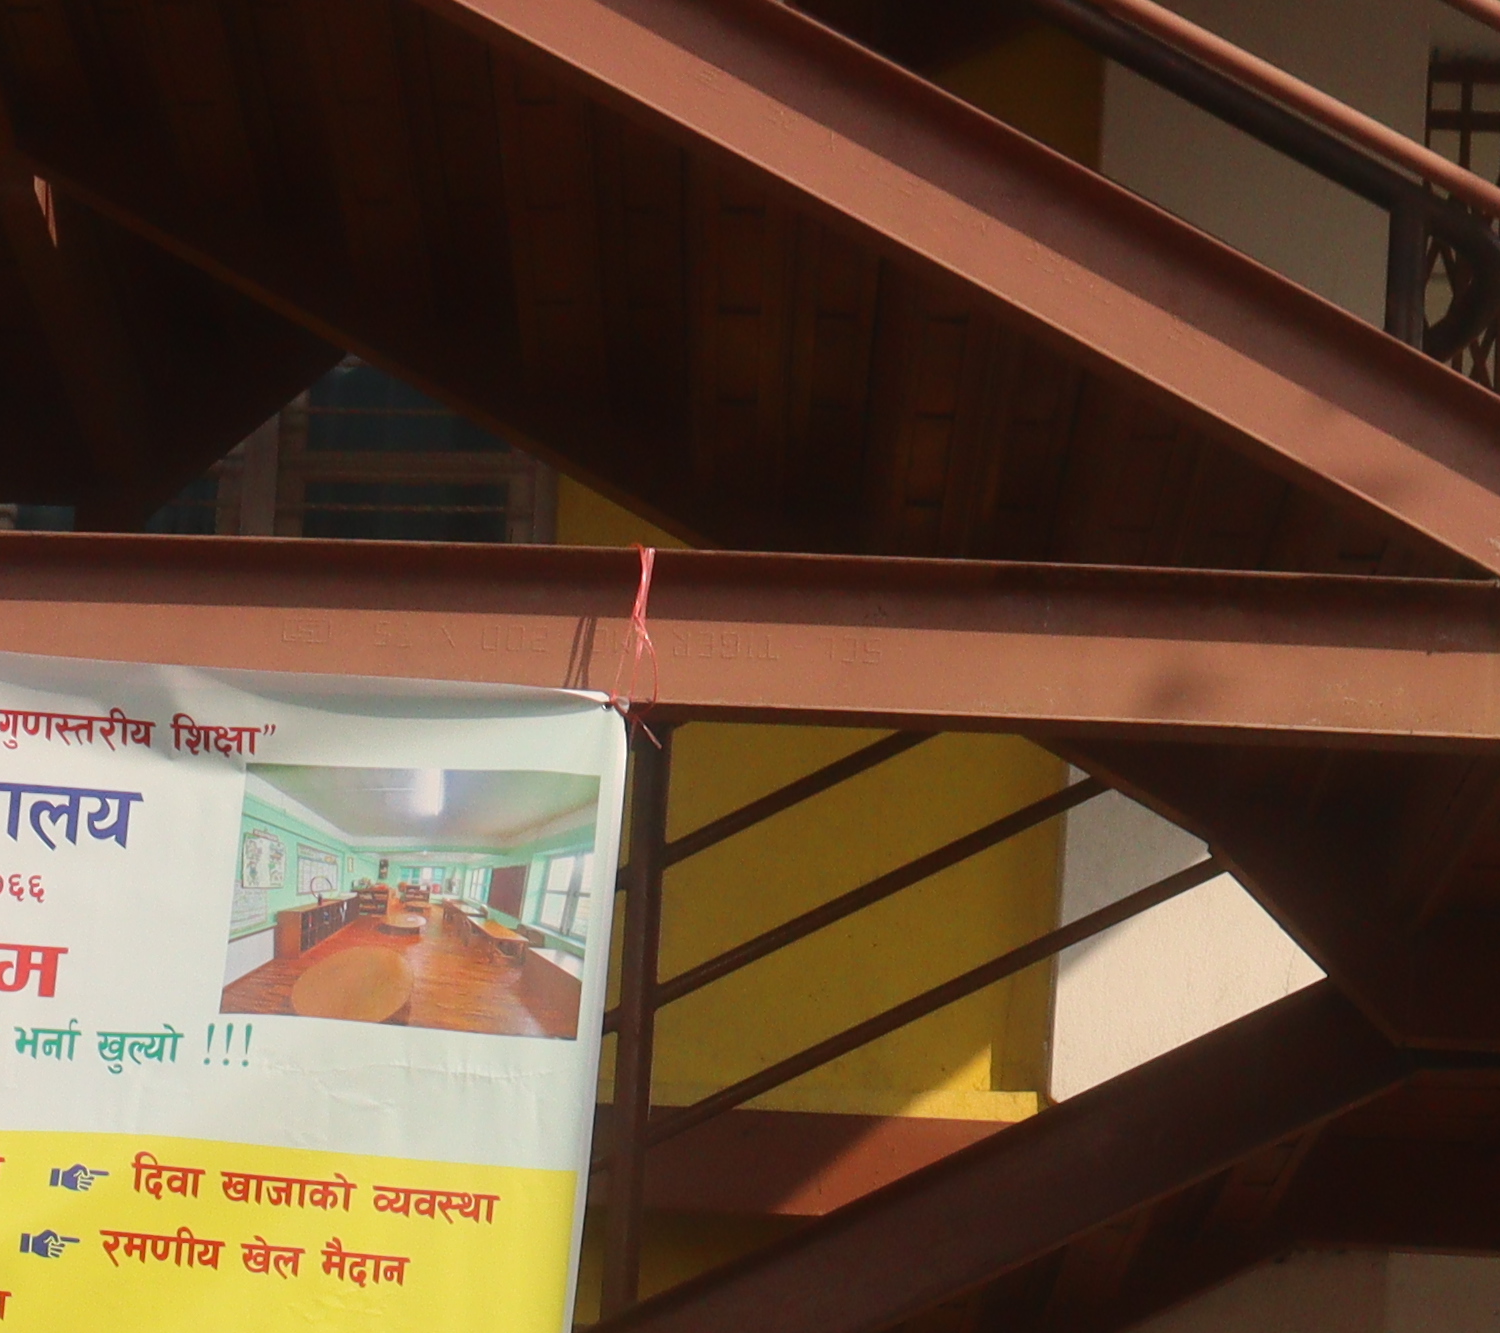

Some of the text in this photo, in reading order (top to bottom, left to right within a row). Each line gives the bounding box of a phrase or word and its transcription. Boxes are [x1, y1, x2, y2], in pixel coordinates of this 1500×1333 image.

[14, 1018, 82, 1060] भर्ना
[97, 1024, 185, 1075] खुल्यो
[131, 1151, 501, 1223] दिवा खाजाको व्यवस्था
[100, 1226, 411, 1288] रमणीय खेल मैदान
